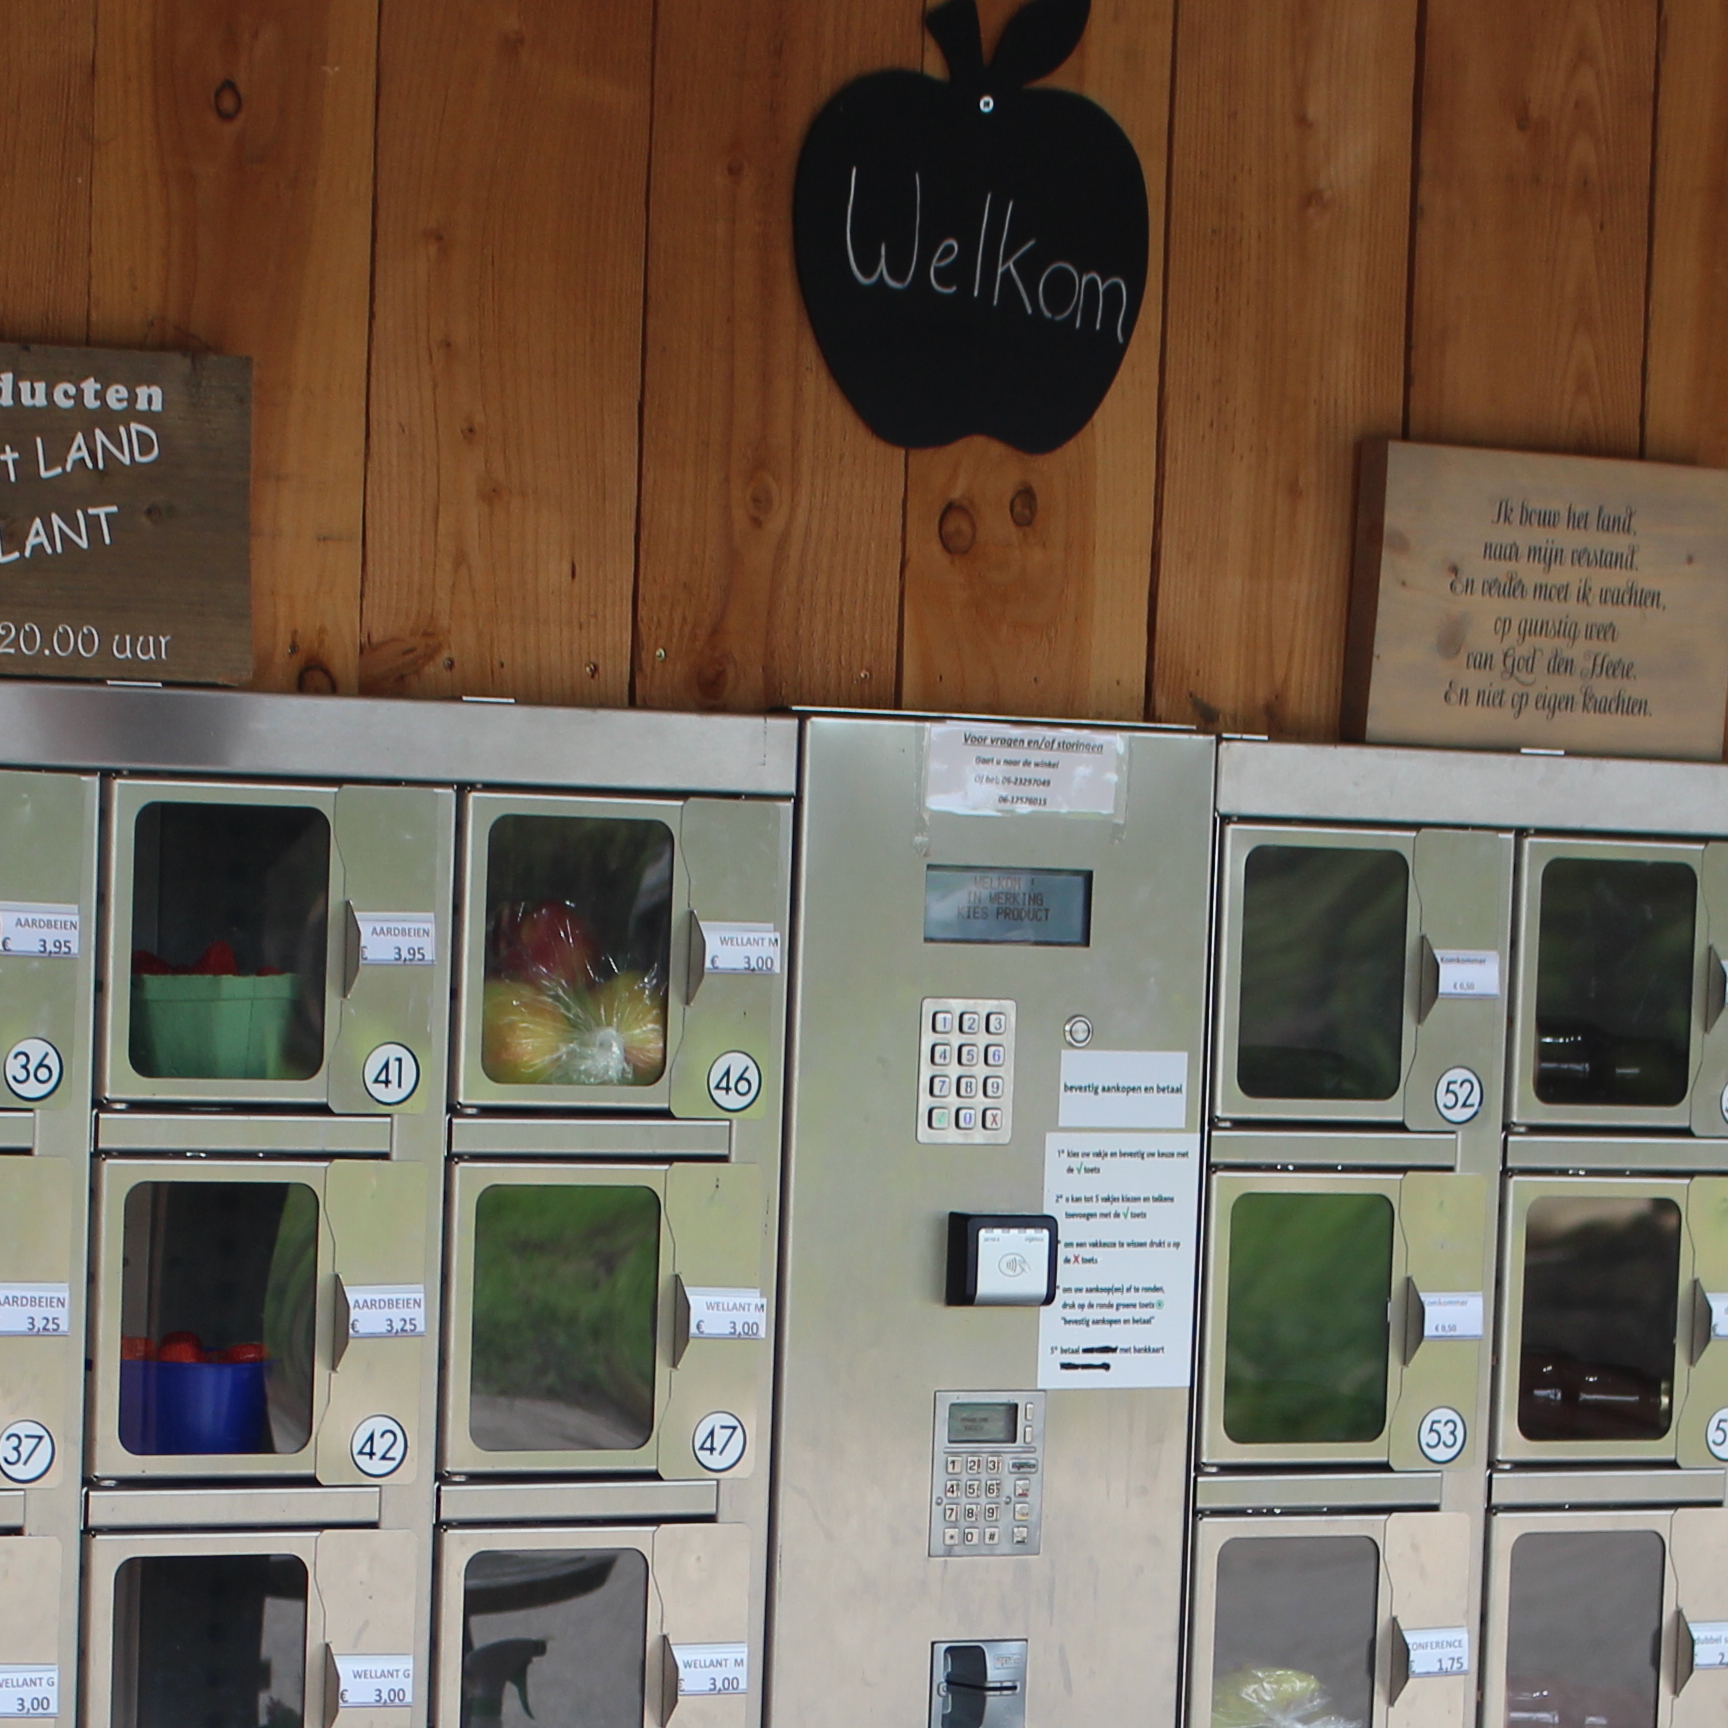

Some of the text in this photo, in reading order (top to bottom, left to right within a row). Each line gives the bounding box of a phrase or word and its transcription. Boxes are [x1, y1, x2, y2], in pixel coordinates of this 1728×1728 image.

[846, 166, 1126, 344] Welkom
[35, 422, 160, 479] LAND
[1491, 499, 1637, 536] Ik bouw het land,
[1482, 539, 1639, 574] naar mijn verstand.
[1449, 568, 1666, 610] En verder moet ik wachten,
[112, 631, 170, 661] uur
[1494, 614, 1618, 648] op gunstig weer
[1466, 647, 1636, 685] van God den Heere.
[1444, 679, 1652, 720] En niet op eigen krachten.
[963, 732, 1103, 754] Voor vragen en/of storingen
[975, 876, 1021, 890] WELKOM
[957, 906, 1050, 921] KIES PRODUCT
[968, 891, 1044, 906] IN WERKING
[12, 1051, 52, 1084] 36
[373, 1057, 402, 1088] 41
[714, 1065, 751, 1096] 46
[1064, 1082, 1099, 1096] bevestig
[1101, 1083, 1142, 1096] aankopen
[1156, 1084, 1182, 1094] betaal
[1443, 1079, 1474, 1110] 52
[352, 1298, 422, 1310] AARDBEIEN
[350, 1318, 417, 1334] € 3,25
[698, 1425, 738, 1455] 47
[1426, 1419, 1457, 1449] 53
[46, 1676, 55, 1687] G
[17, 1697, 50, 1713] 3,00
